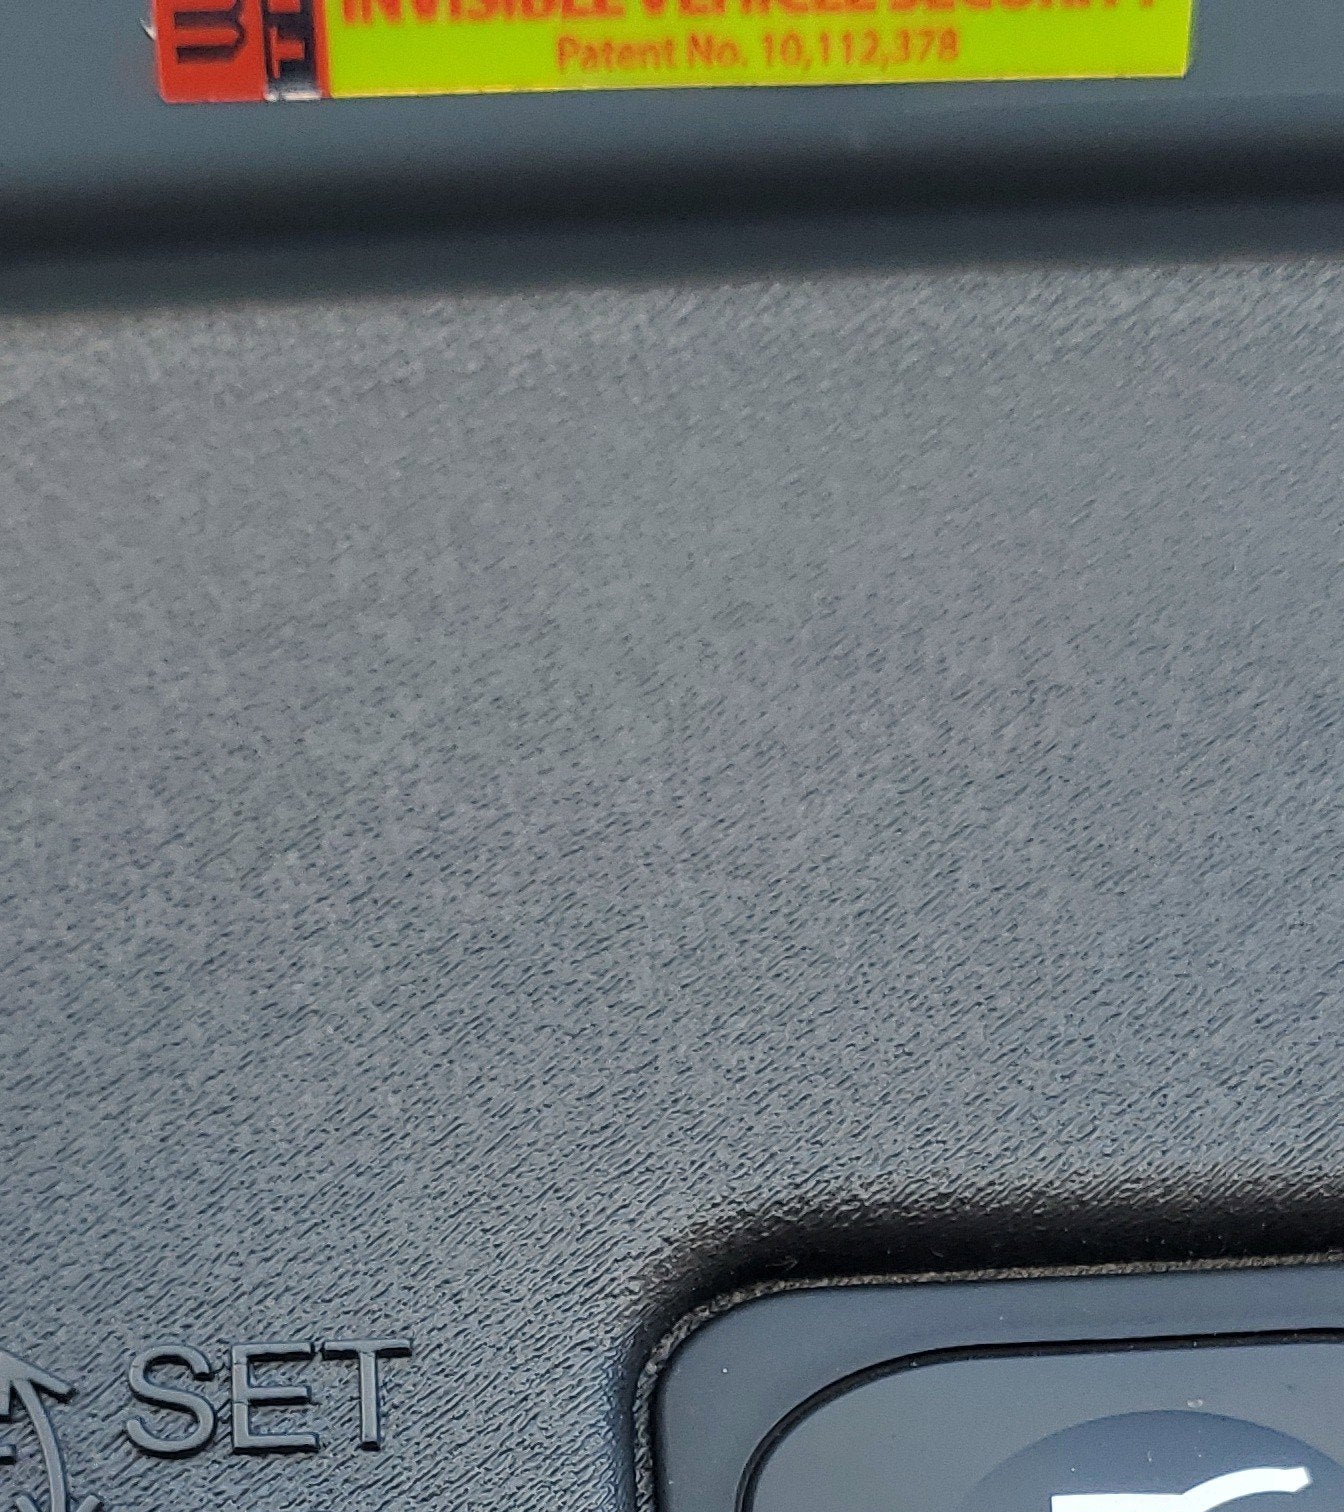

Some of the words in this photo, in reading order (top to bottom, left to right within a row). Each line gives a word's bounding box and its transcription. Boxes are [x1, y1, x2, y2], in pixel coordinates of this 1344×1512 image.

[557, 34, 676, 72] Patent
[687, 30, 748, 70] No.
[125, 1339, 412, 1459] SET
